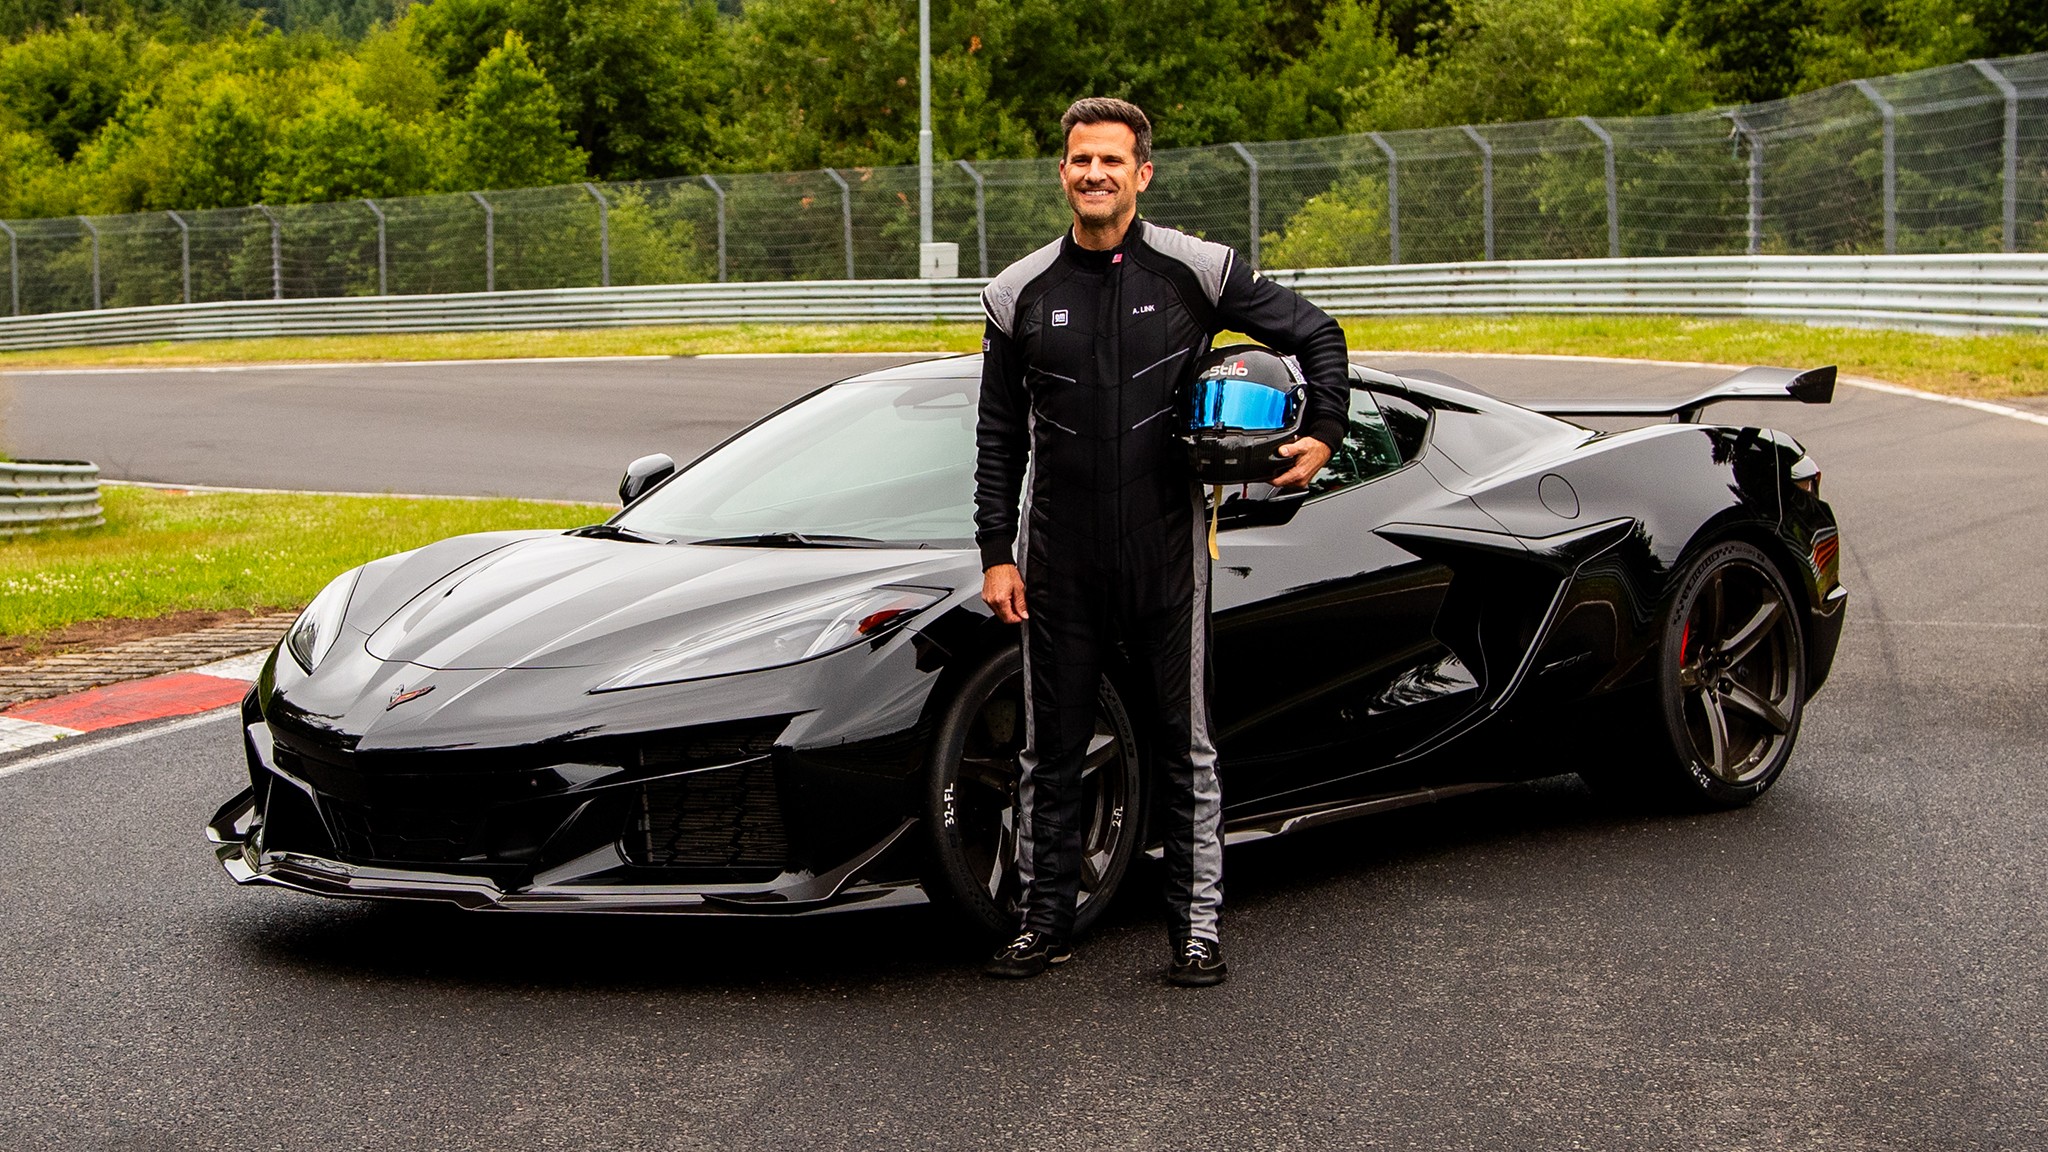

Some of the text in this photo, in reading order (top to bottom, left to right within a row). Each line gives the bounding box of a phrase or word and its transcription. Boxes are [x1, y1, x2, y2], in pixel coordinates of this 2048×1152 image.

[1140, 304, 1156, 314] LINK
[1209, 360, 1249, 377] stilo
[943, 782, 955, 828] 32-FL
